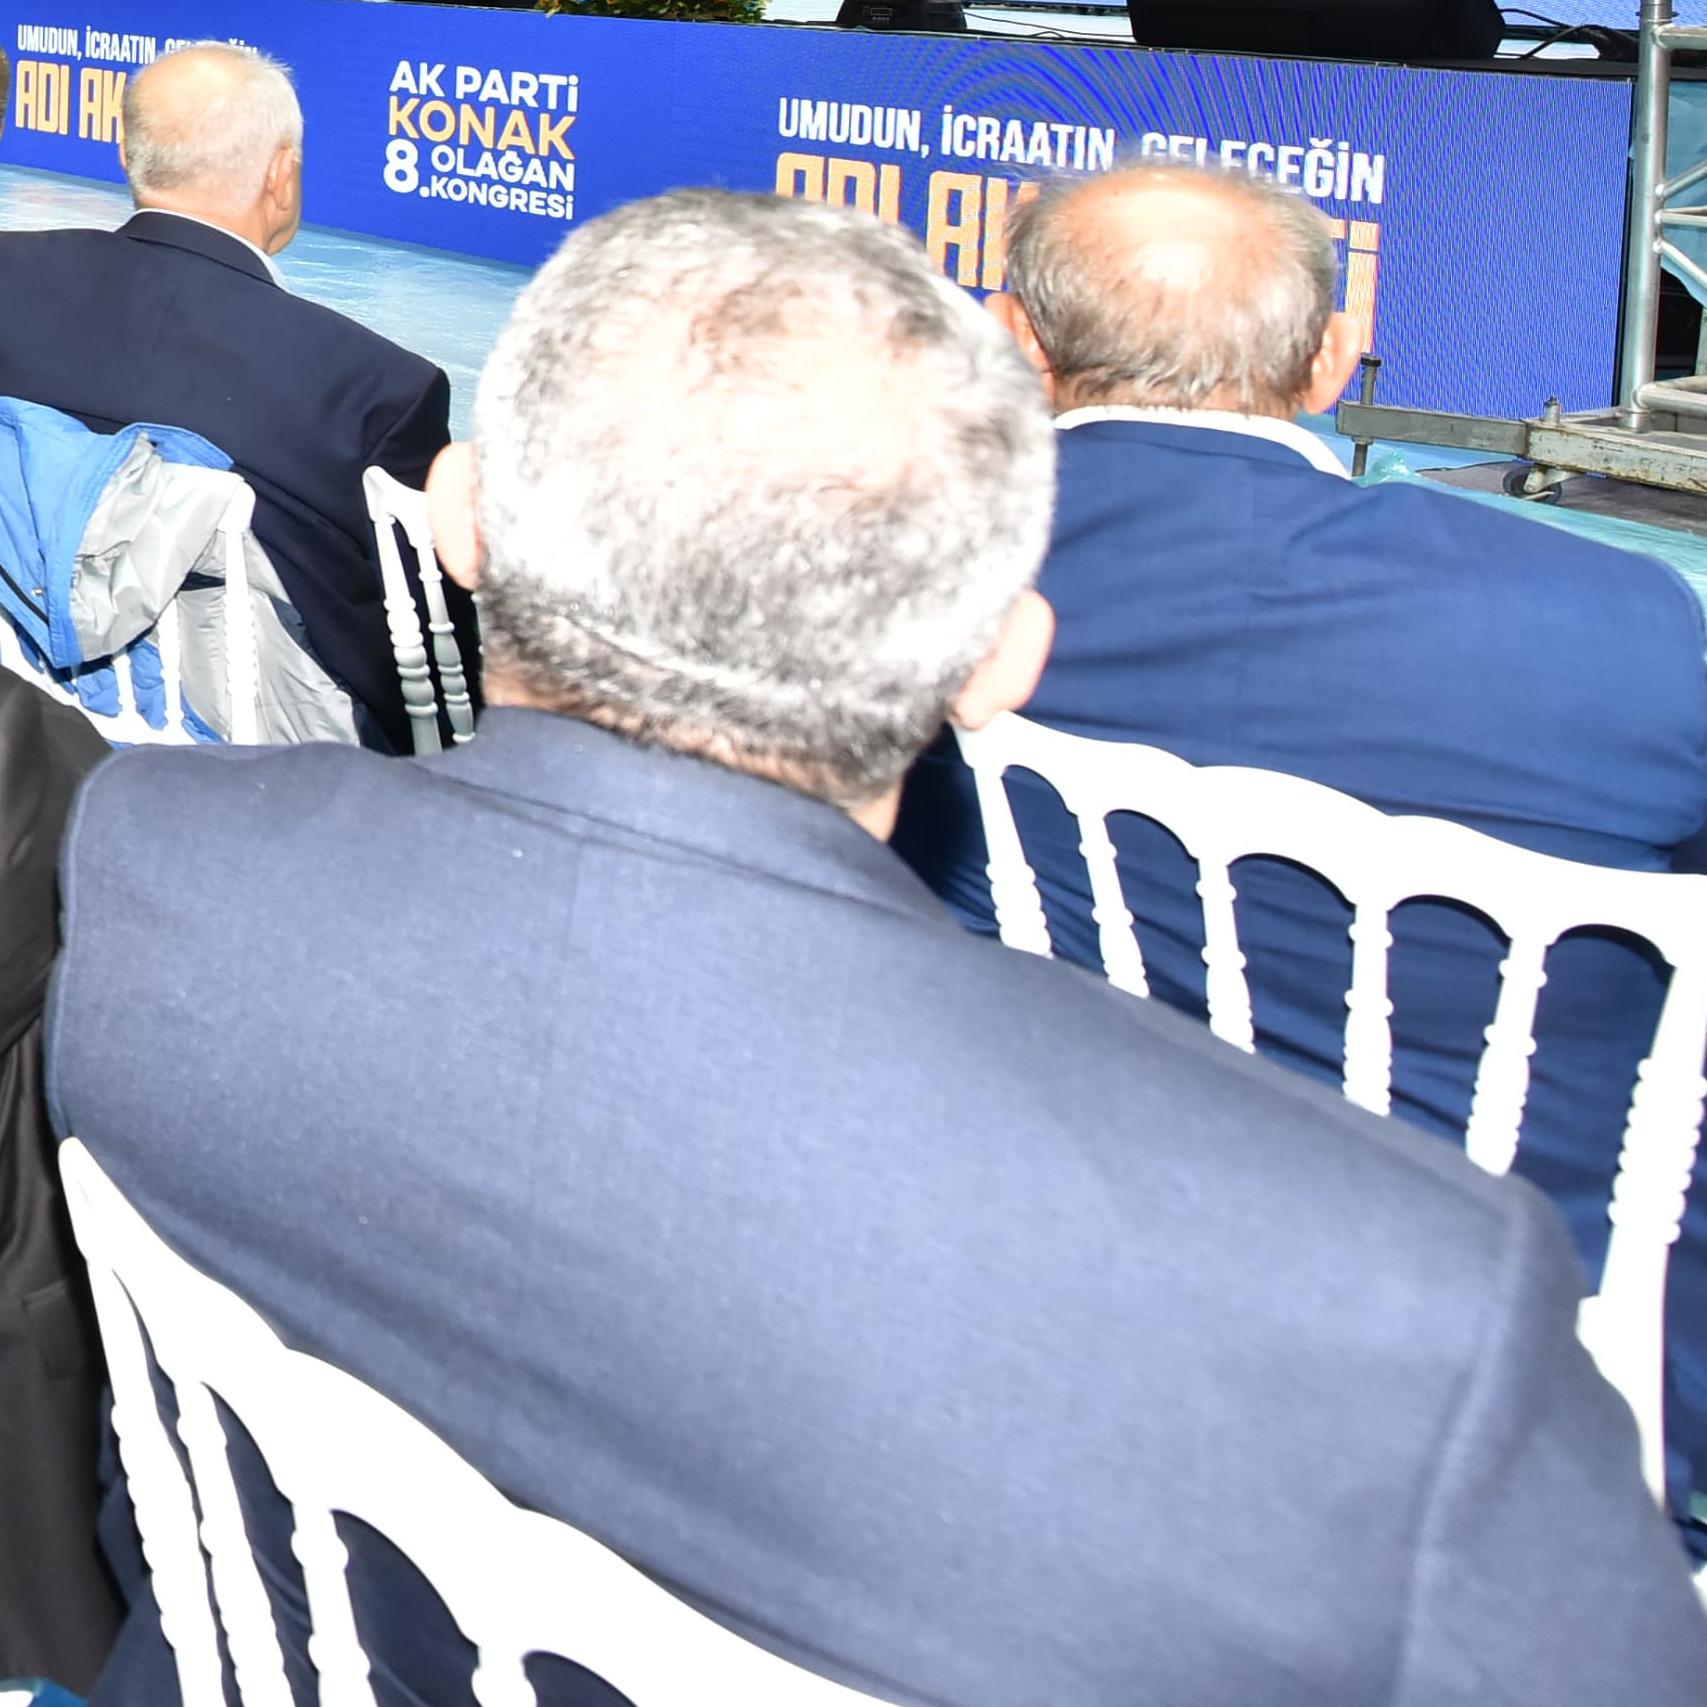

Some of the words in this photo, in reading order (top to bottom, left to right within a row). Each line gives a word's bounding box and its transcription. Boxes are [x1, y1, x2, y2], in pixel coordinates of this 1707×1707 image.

[17, 24, 82, 61] UMUDUN,
[15, 60, 70, 135] ADI
[78, 67, 127, 144] AK
[389, 60, 445, 98] AK
[388, 95, 576, 161] KONAK
[779, 97, 930, 159] UMUDUN,
[431, 145, 575, 192] OLAĞAN
